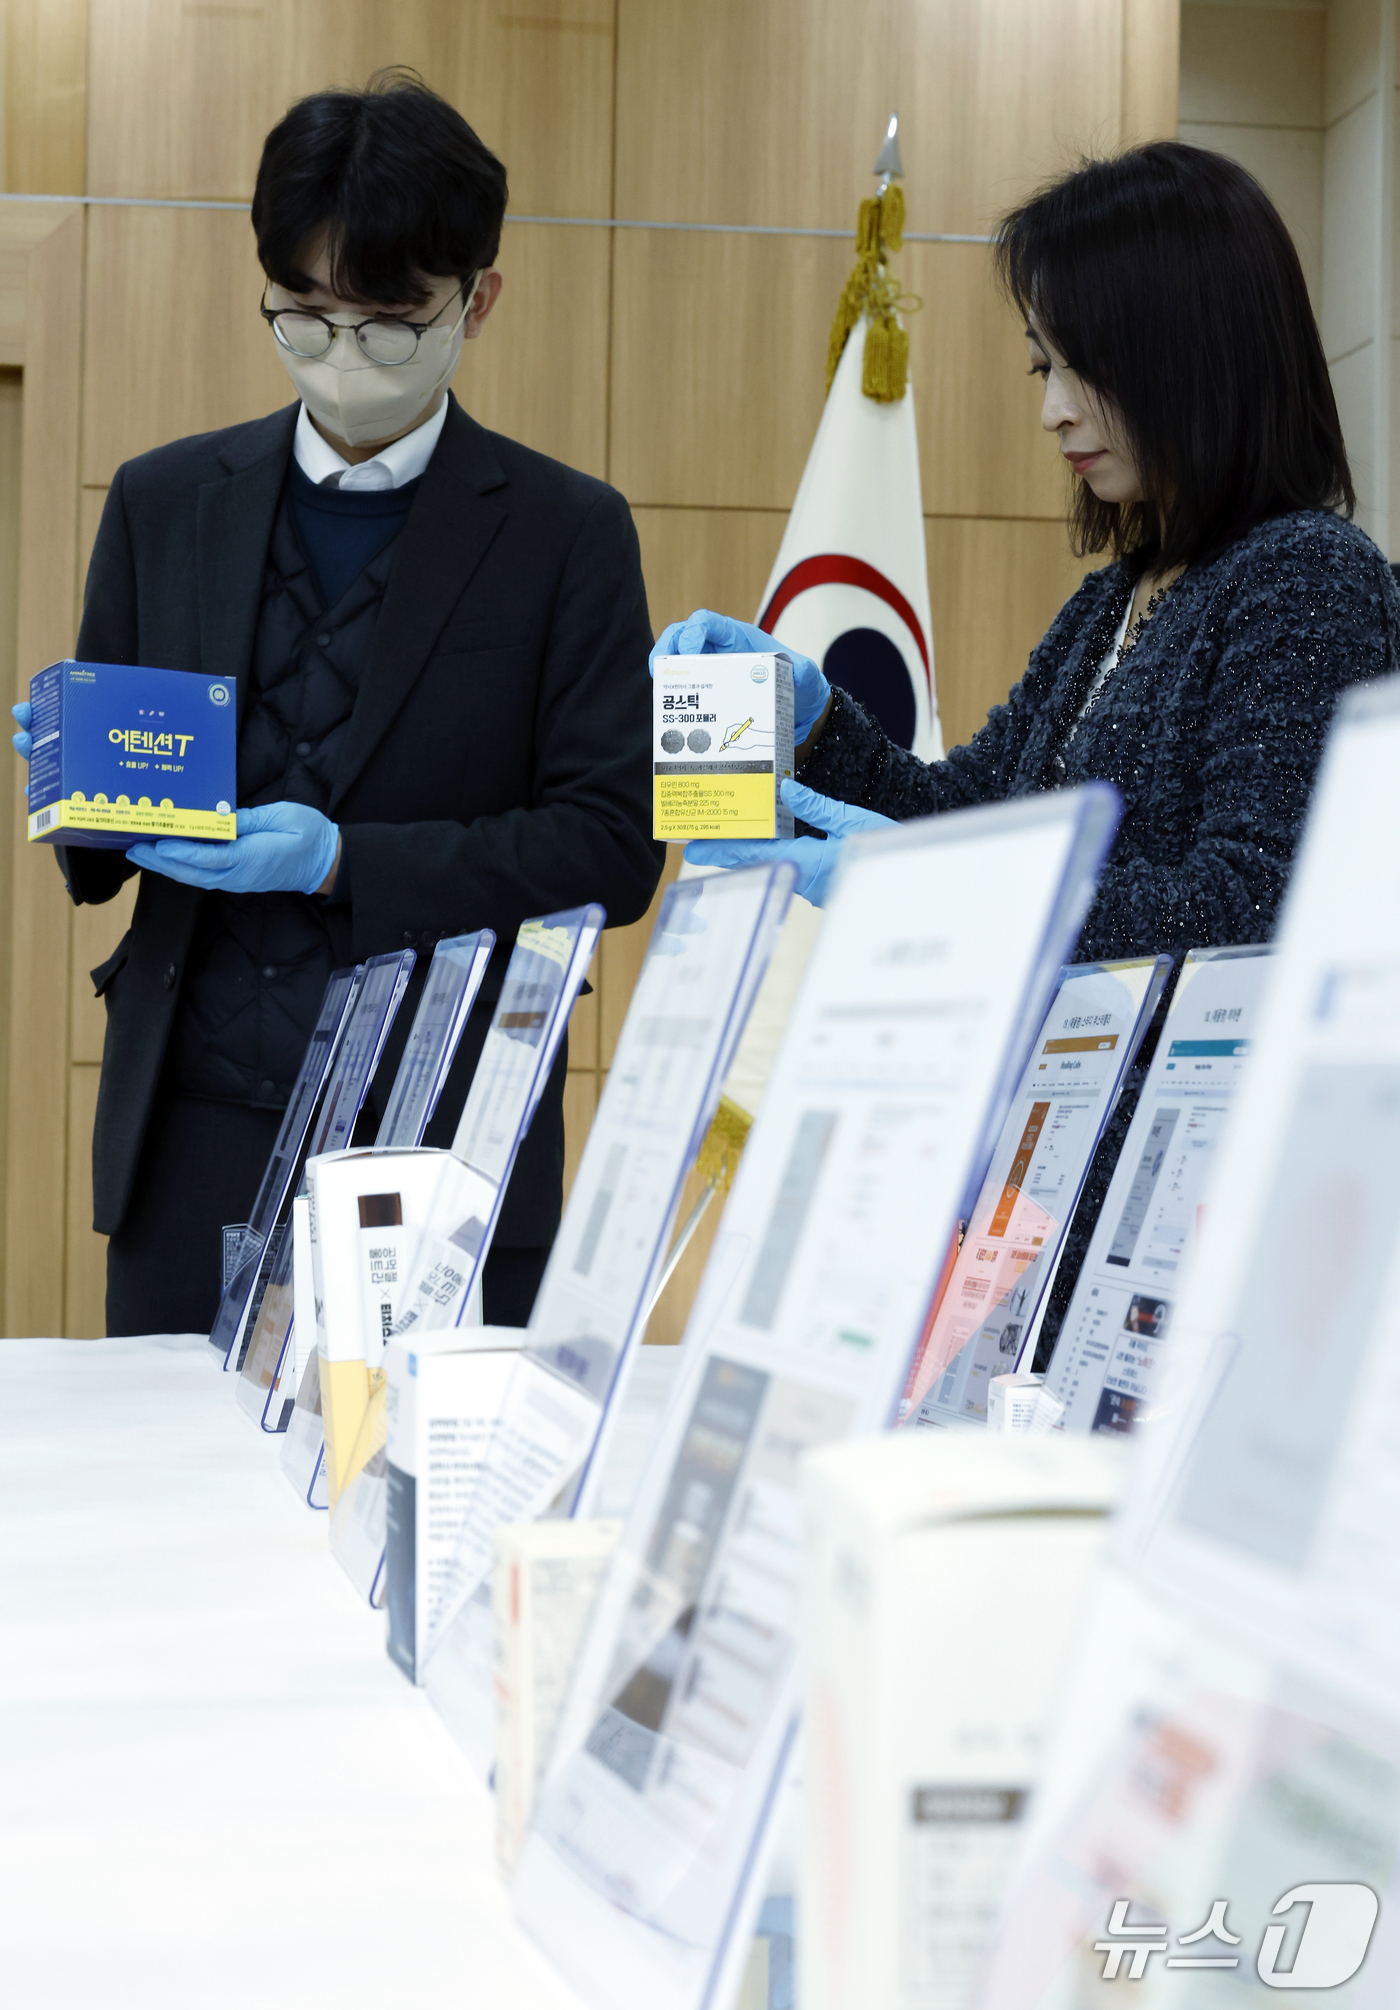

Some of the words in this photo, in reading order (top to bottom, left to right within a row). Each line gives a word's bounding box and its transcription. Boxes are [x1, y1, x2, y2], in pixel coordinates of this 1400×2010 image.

[662, 691, 699, 710] 공스틱
[662, 714, 695, 723] SS-300
[696, 713, 717, 723] 포뮬러
[137, 762, 149, 770] UP!
[173, 765, 184, 773] UP!
[660, 781, 677, 789] 타우린
[722, 808, 728, 816] 15
